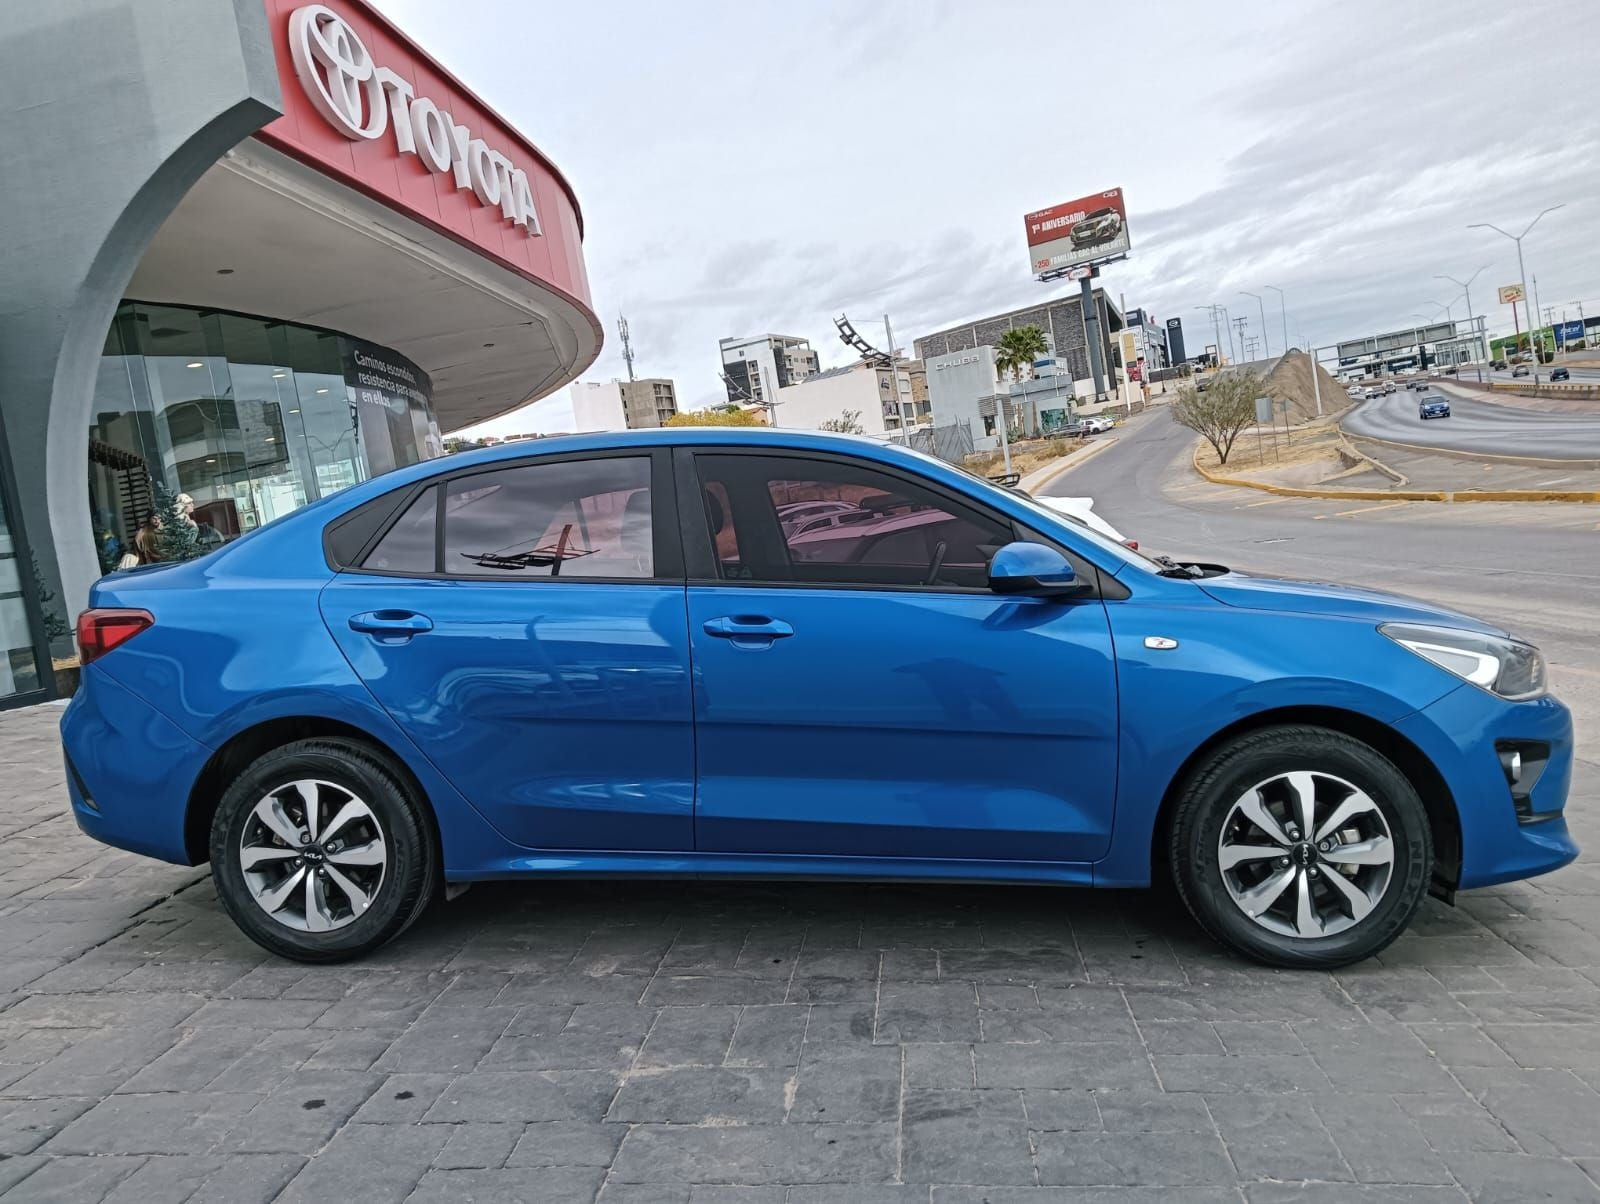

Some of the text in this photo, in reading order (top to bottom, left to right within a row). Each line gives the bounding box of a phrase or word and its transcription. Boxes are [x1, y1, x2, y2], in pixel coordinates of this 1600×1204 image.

[374, 66, 543, 238] TOYOTA
[1041, 211, 1086, 232] ANIVERSARIO
[354, 350, 387, 372] Caminos
[358, 371, 395, 392] resistencia
[362, 391, 373, 404] en
